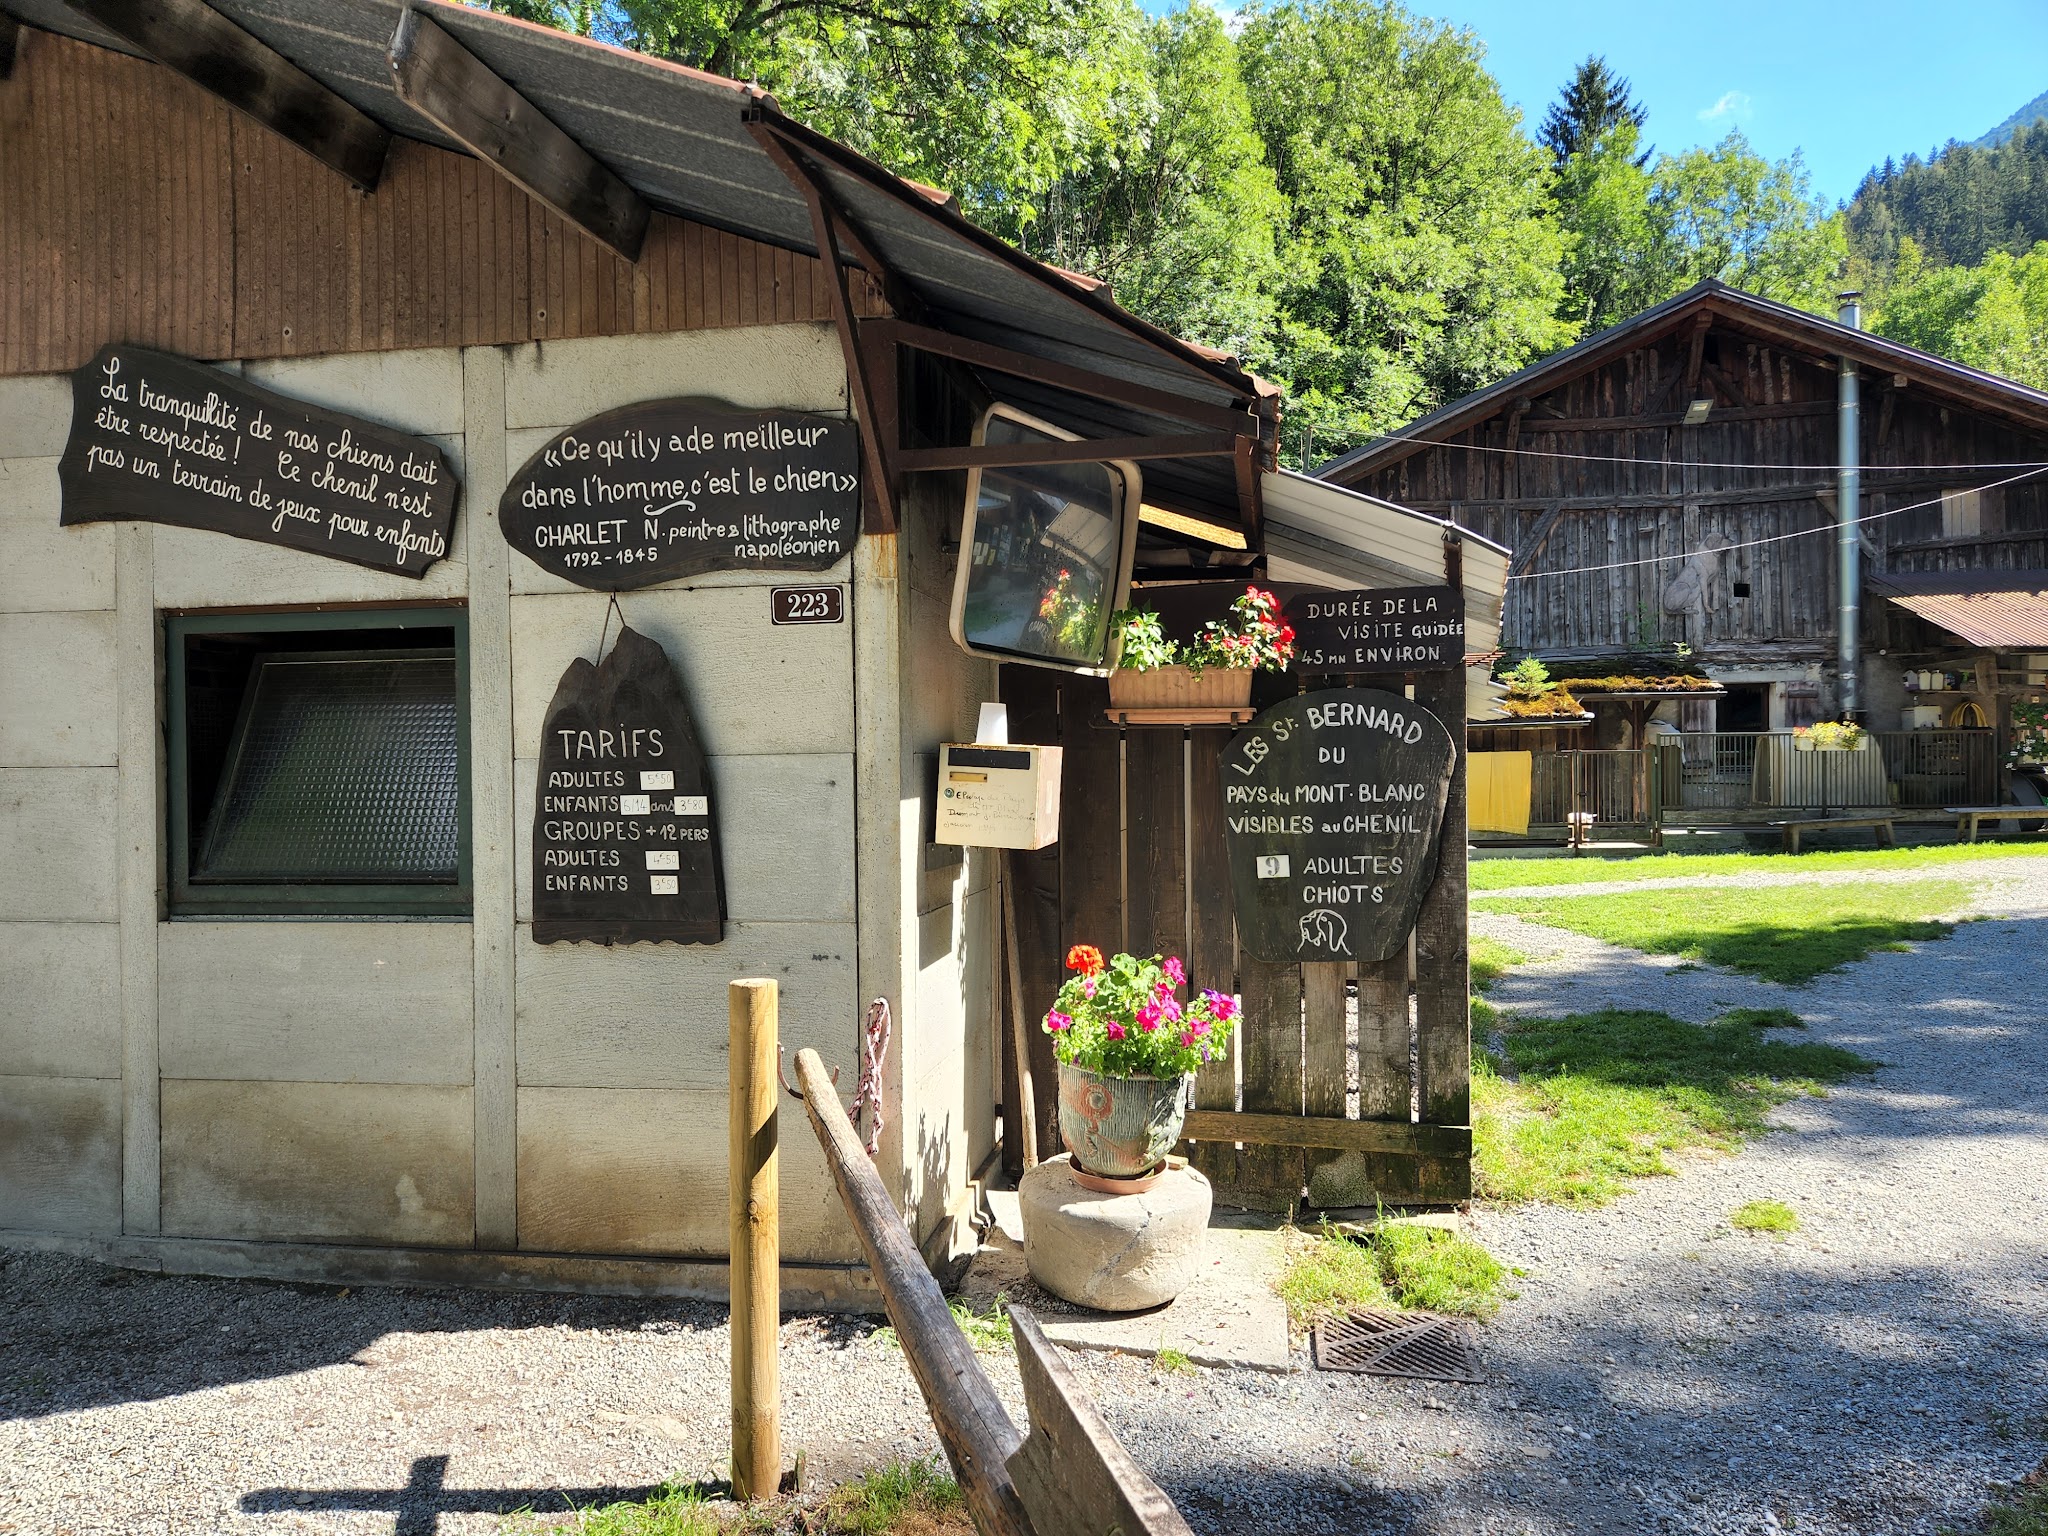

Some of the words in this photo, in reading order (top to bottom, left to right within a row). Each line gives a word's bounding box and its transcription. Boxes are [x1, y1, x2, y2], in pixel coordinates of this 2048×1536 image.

[100, 357, 129, 403] La
[249, 410, 273, 441] de
[285, 429, 320, 454] nos
[327, 429, 395, 474] chiens
[400, 452, 438, 485] doit
[723, 421, 829, 451] meilleur
[95, 407, 131, 436] être
[139, 422, 227, 462] respectée
[277, 450, 302, 483] Ce
[311, 472, 379, 503] chenil
[385, 487, 433, 518] n'est
[521, 481, 576, 509] dans
[691, 468, 742, 496] c'est
[748, 465, 767, 493] le
[87, 443, 125, 472] pas
[132, 457, 160, 478] un
[171, 459, 243, 503] terrain
[249, 478, 273, 511] de
[271, 496, 322, 532] jeux
[328, 511, 370, 539] pour
[374, 516, 446, 565] enfants
[535, 519, 628, 548] CHARLET
[668, 522, 726, 545] peintre
[742, 509, 842, 541] lithographe
[733, 534, 840, 561] napoléonien
[787, 592, 830, 619] 223
[1307, 594, 1372, 619] DURÉE
[1382, 598, 1406, 616] DE
[1412, 597, 1438, 613] LA
[1302, 650, 1324, 664] 45
[1328, 654, 1346, 664] MN
[1231, 736, 1270, 776] LES
[1306, 702, 1423, 744] BERNARD
[1318, 747, 1346, 764] DU
[548, 771, 625, 788] ADULTES
[544, 795, 619, 813] ENFANTS
[650, 798, 675, 812] ans
[1227, 786, 1268, 803] PAYS
[1270, 787, 1290, 806] du
[544, 820, 641, 841] GROUPES
[659, 824, 678, 841] 12
[679, 828, 709, 841] PERS
[1321, 821, 1340, 833] au
[544, 850, 620, 867] ADULTES
[1266, 857, 1280, 876] 9
[1303, 855, 1404, 876] ADULTES
[545, 875, 629, 891] ENFANTS
